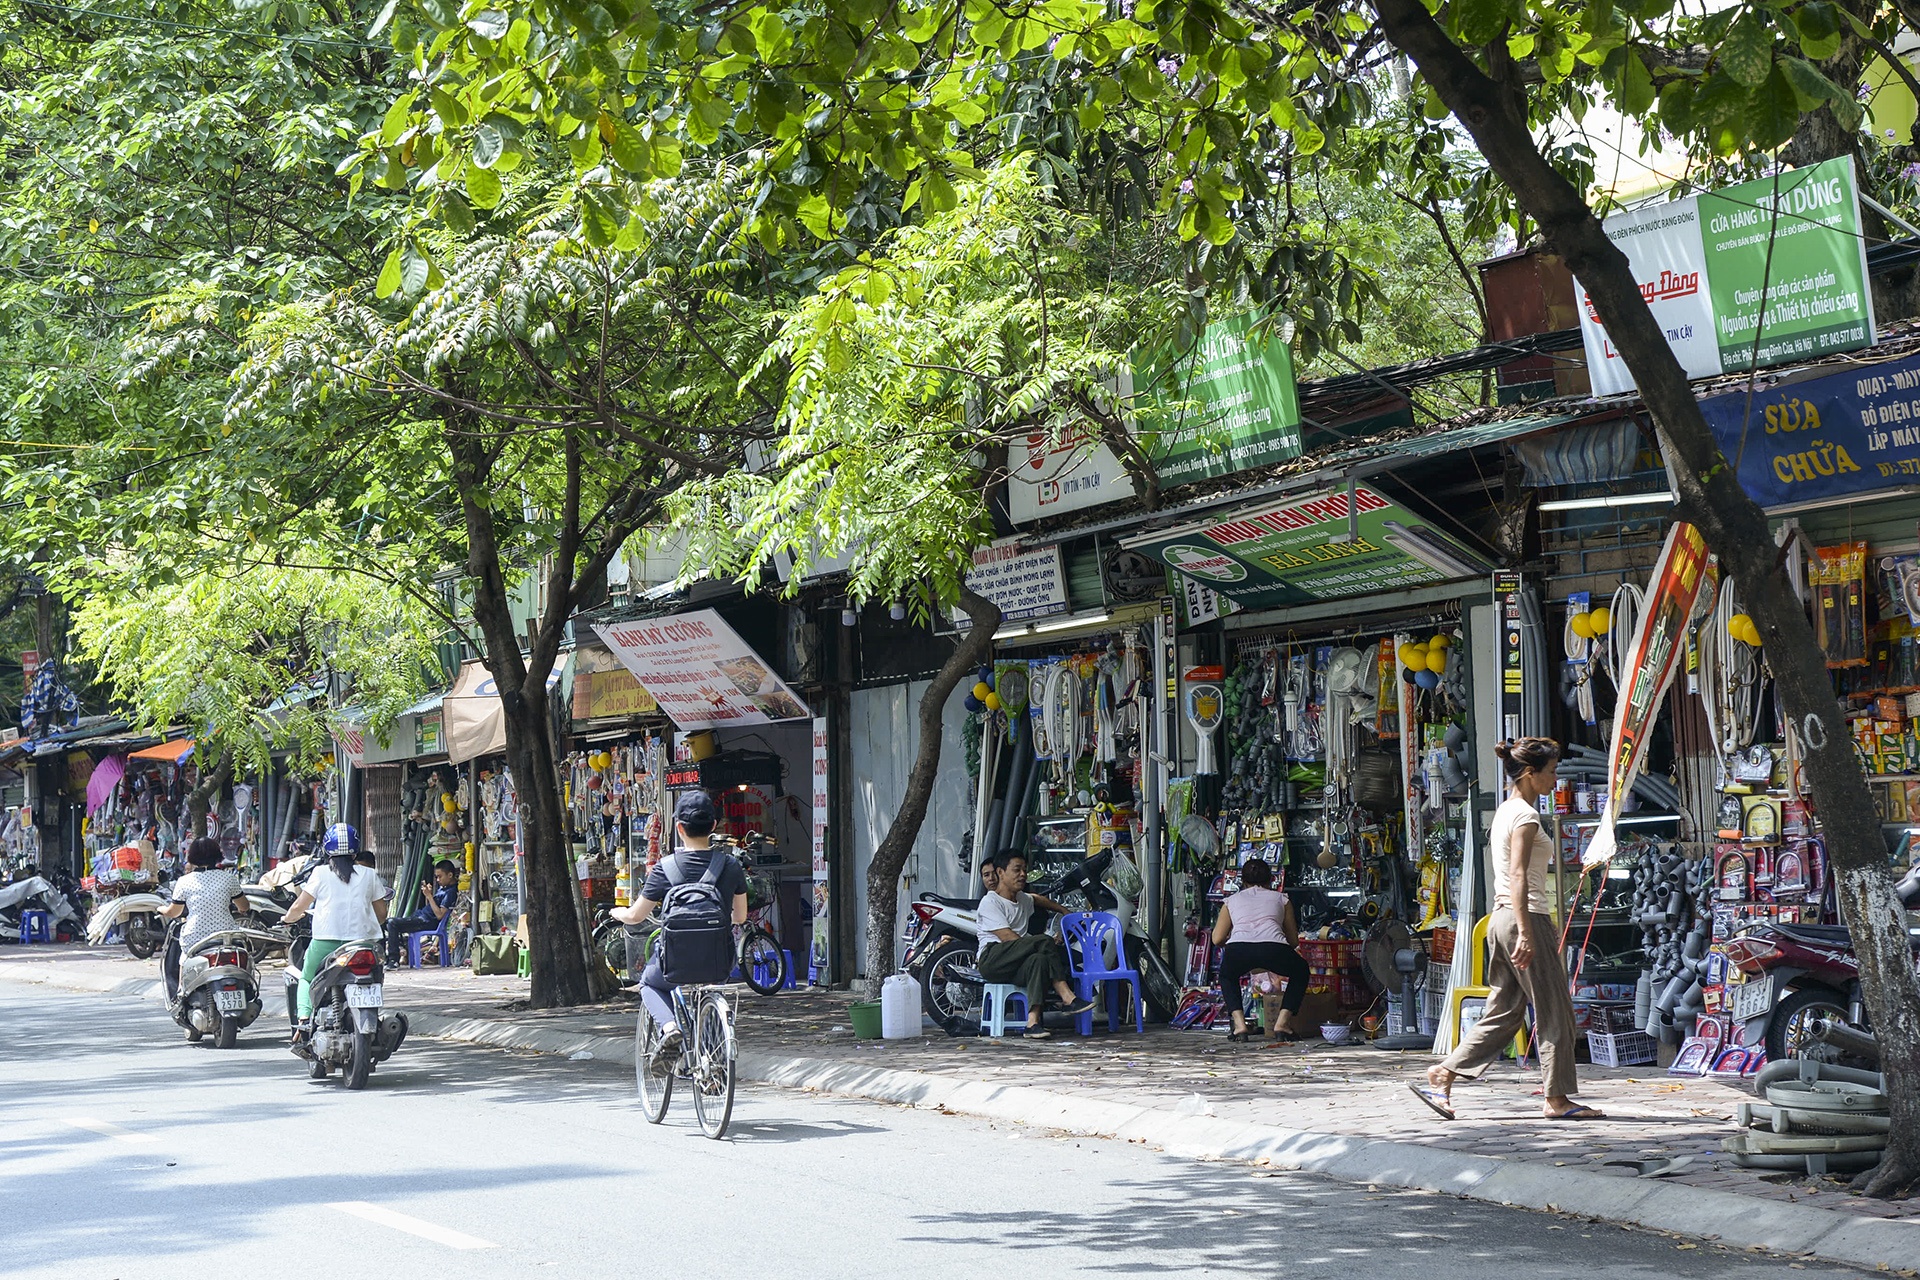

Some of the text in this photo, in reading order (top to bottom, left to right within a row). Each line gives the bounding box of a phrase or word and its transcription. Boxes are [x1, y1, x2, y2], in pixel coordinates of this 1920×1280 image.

[1710, 213, 1730, 234] CỬA
[1730, 209, 1758, 230] HÀNG
[1793, 177, 1843, 214] DŨNG
[1628, 224, 1645, 236] PHÍCH
[1677, 211, 1695, 226] ĐÔNG
[1734, 287, 1760, 307] Chuyên
[1777, 279, 1790, 299] cấp
[1789, 278, 1801, 293] các
[1720, 309, 1749, 338] Nguồn
[1775, 298, 1801, 323] Thiết
[1800, 298, 1811, 322] bị
[1810, 290, 1836, 317] chiếu
[1836, 289, 1859, 313] sáng
[1666, 323, 1693, 342] TIN CẬY
[1795, 339, 1803, 353] Hà
[1829, 332, 1840, 346] 043
[1253, 404, 1272, 425] sáng
[1765, 393, 1821, 435] SỬA
[1879, 400, 1911, 424] ĐIỆN
[1773, 439, 1861, 483] CHỮA
[1260, 548, 1312, 570] HÀ
[611, 626, 651, 648] BÁNH
[705, 669, 723, 679] 10K
[724, 688, 742, 697] 10K
[741, 705, 759, 713] 10K
[220, 991, 242, 1001] 30-L9
[221, 1000, 243, 1009] 2570
[1739, 995, 1766, 1017] 6862
